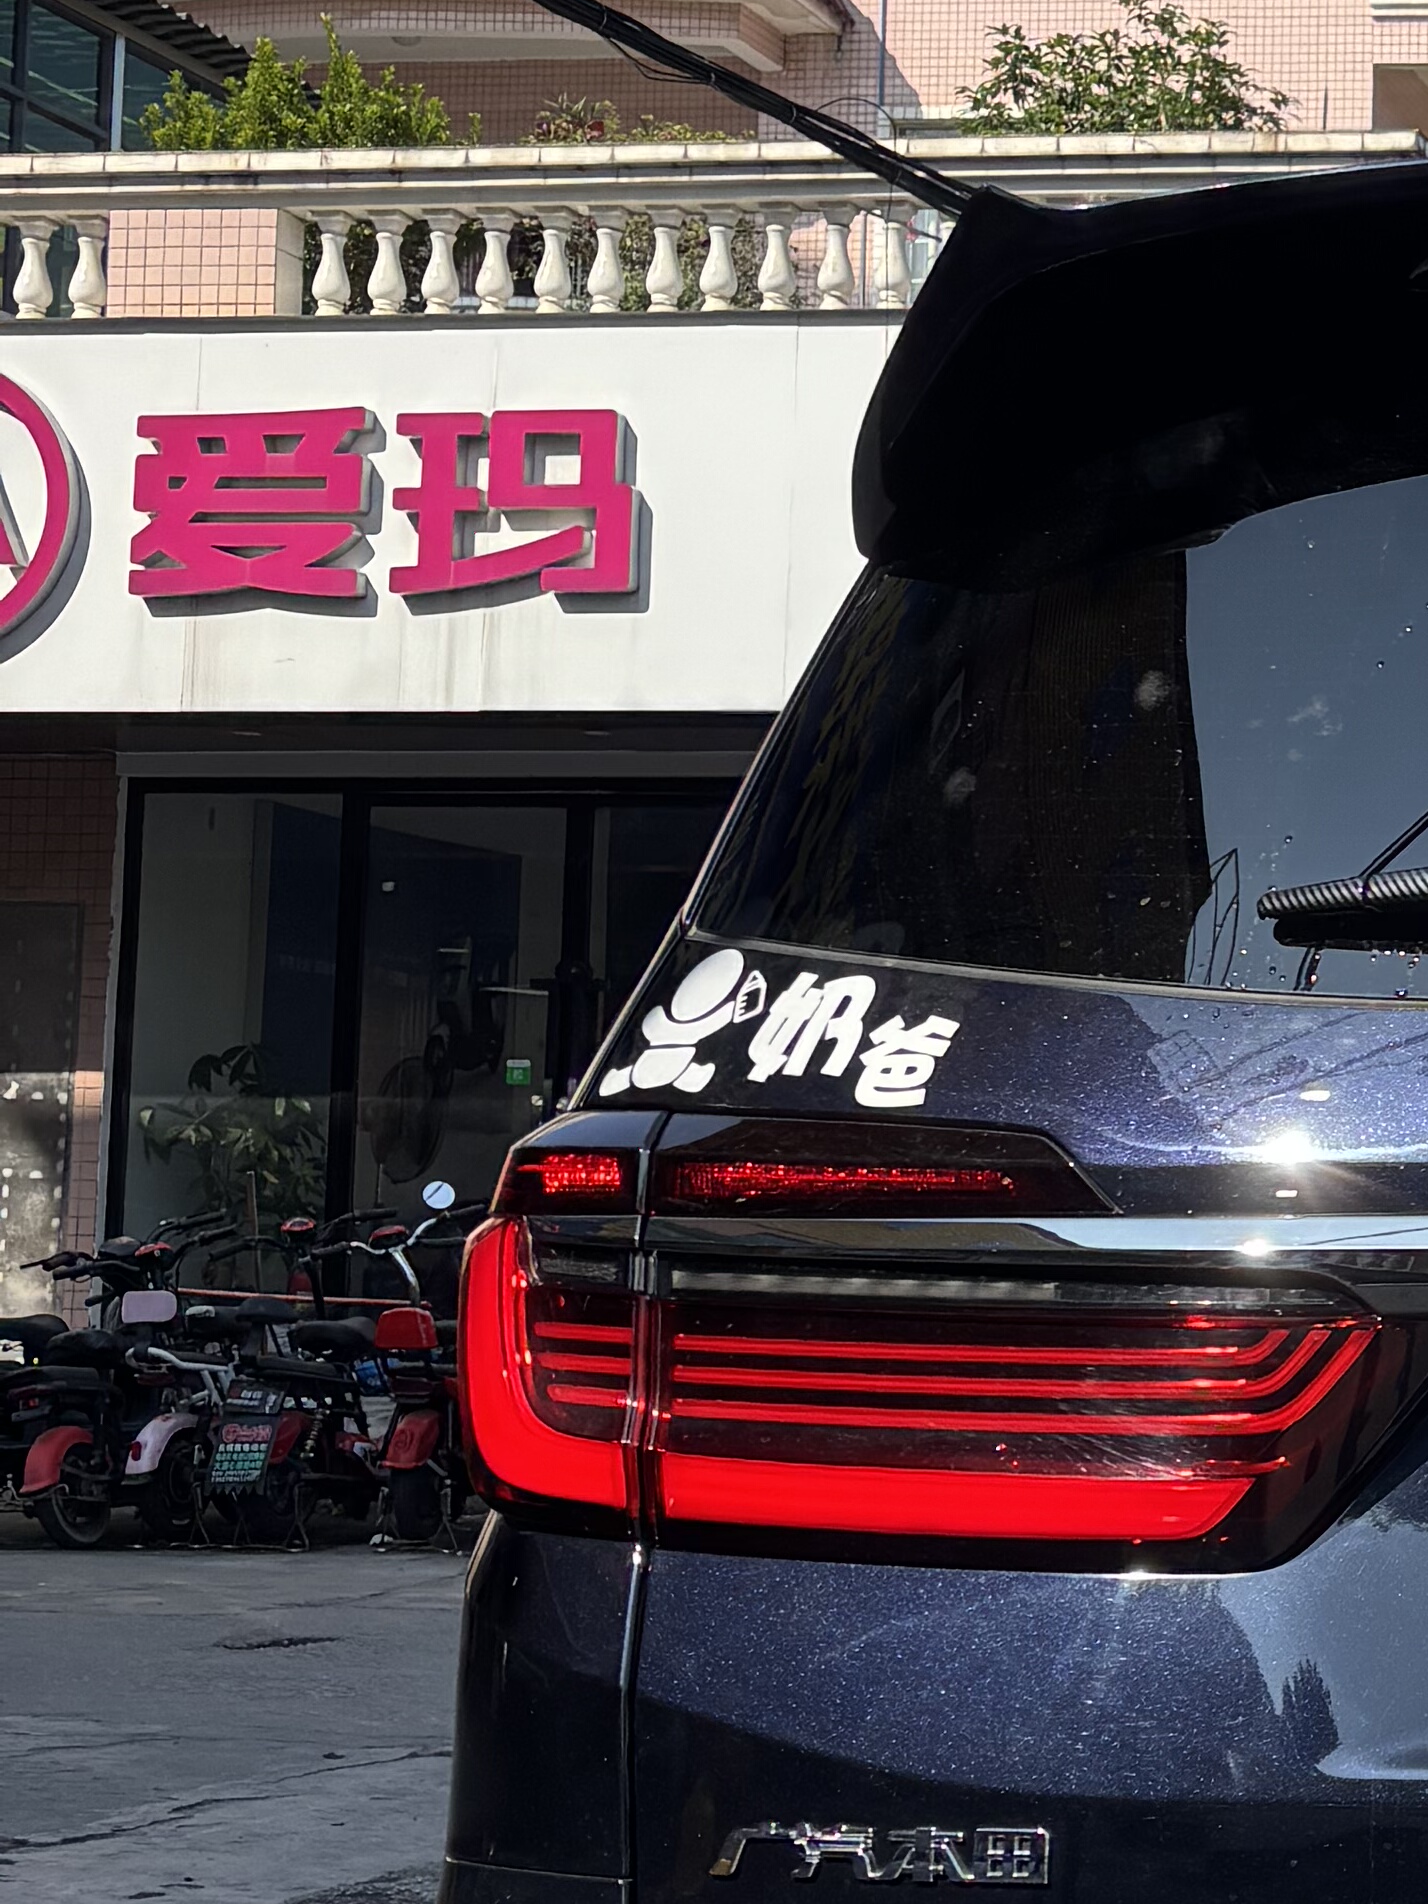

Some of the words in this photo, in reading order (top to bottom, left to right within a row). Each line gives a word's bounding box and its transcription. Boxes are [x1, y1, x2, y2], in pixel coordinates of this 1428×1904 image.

[128, 406, 641, 597] 爱玛
[747, 971, 960, 1108] 奶爸
[707, 1821, 1051, 1884] 广汽本田
